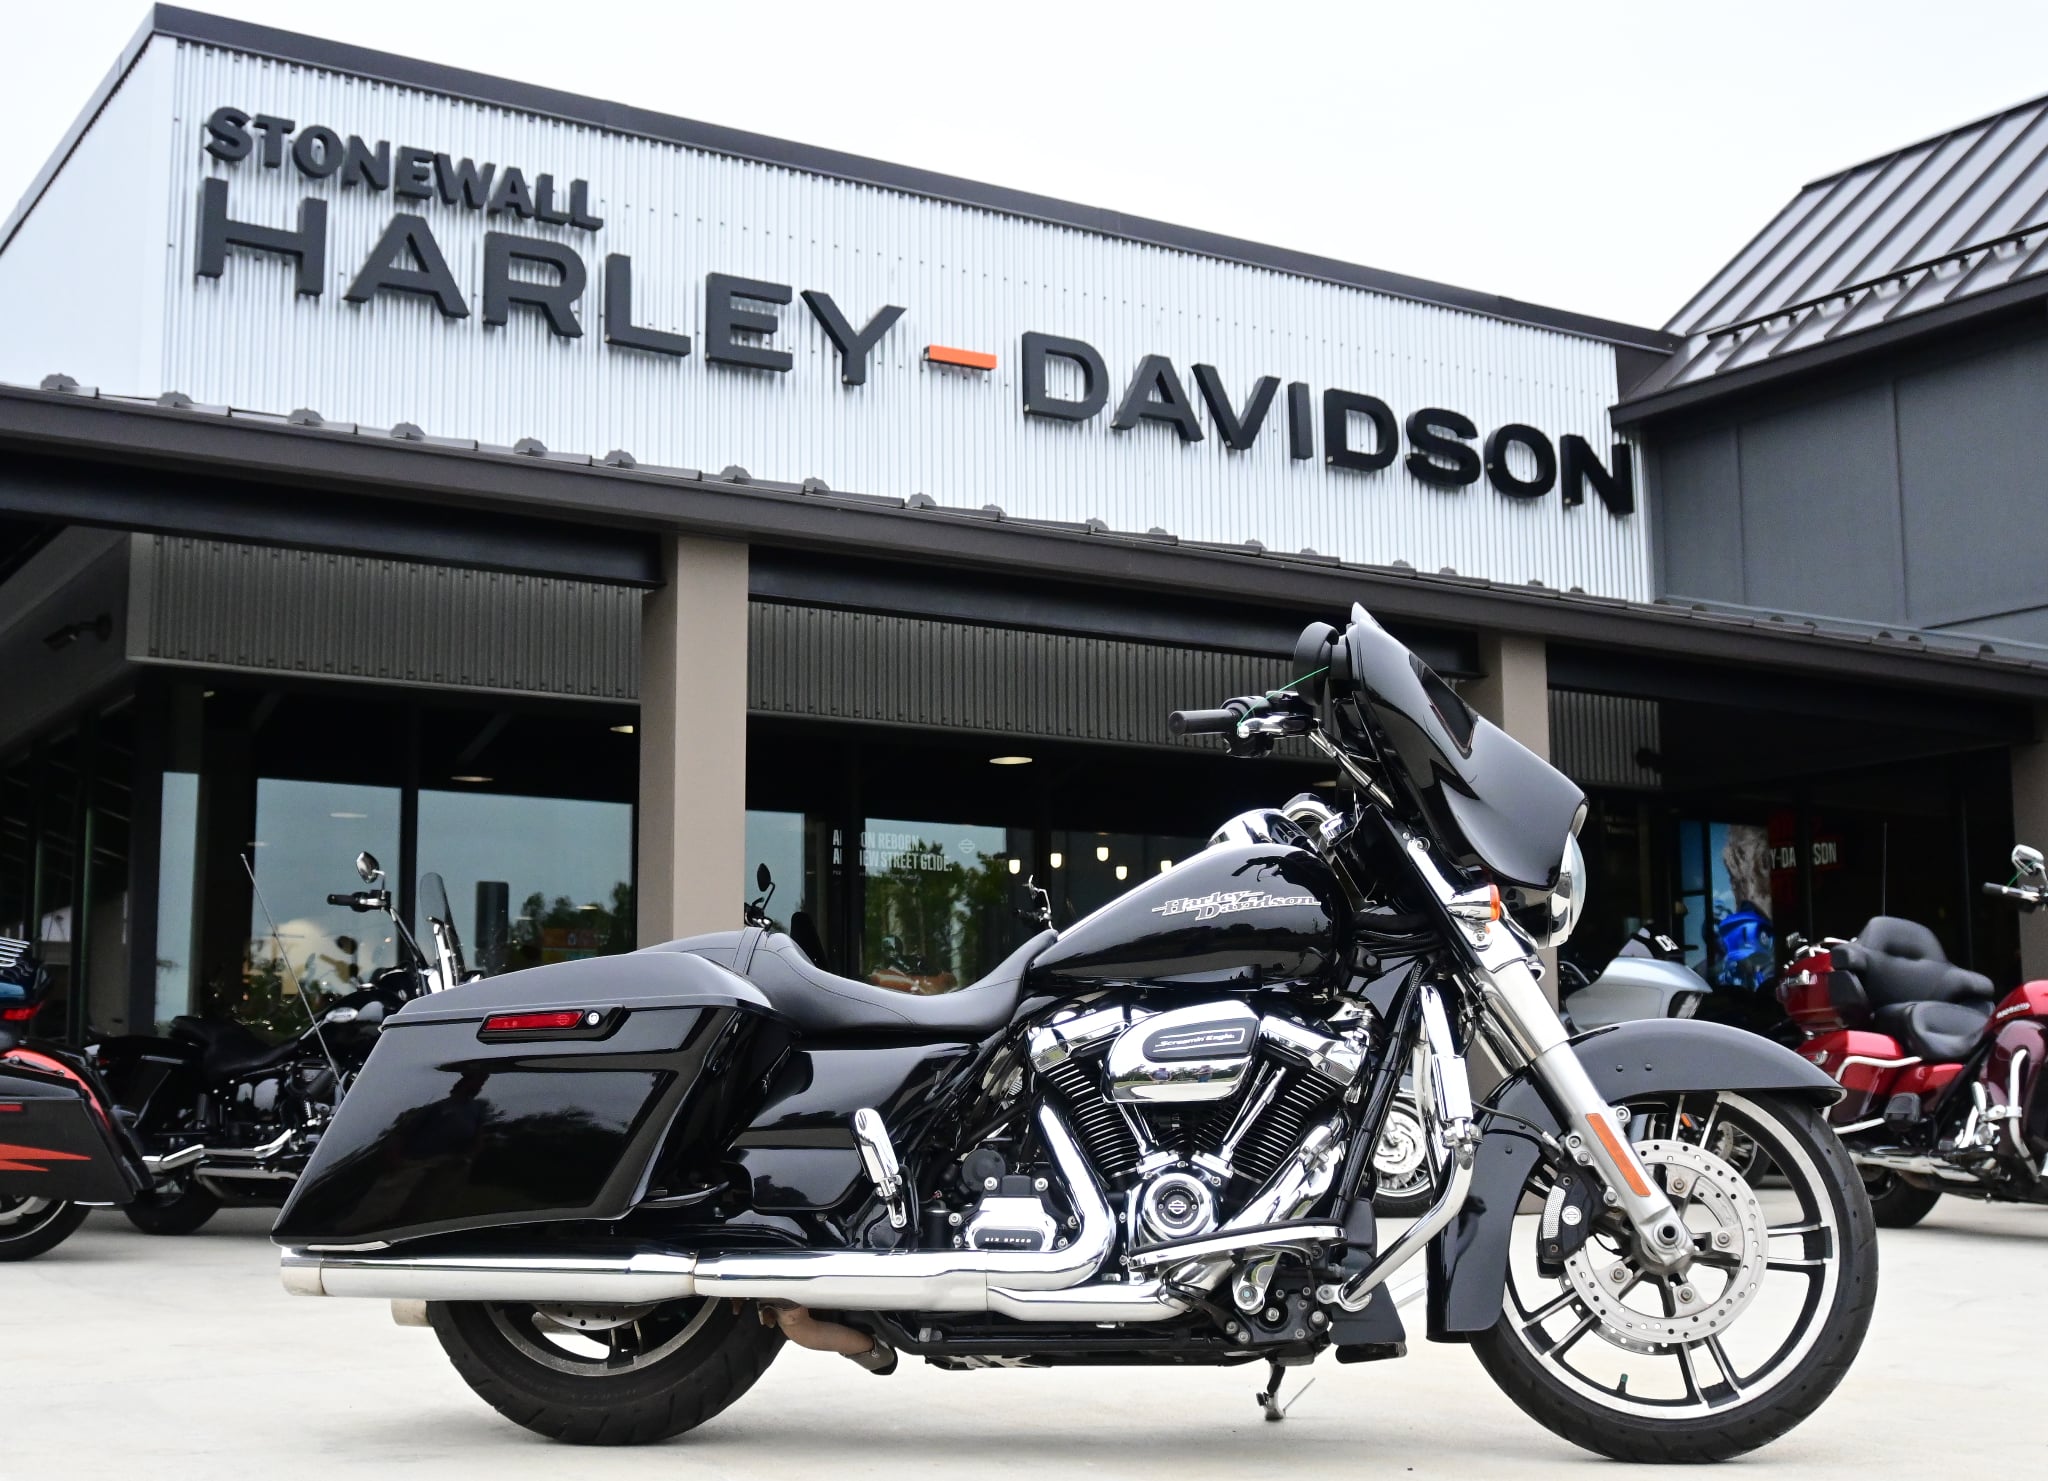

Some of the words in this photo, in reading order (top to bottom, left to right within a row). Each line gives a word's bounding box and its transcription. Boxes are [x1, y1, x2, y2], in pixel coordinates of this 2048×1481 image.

[205, 106, 603, 231] STONEWALL
[880, 851, 918, 870] STREET
[920, 854, 953, 872] GLIDE.
